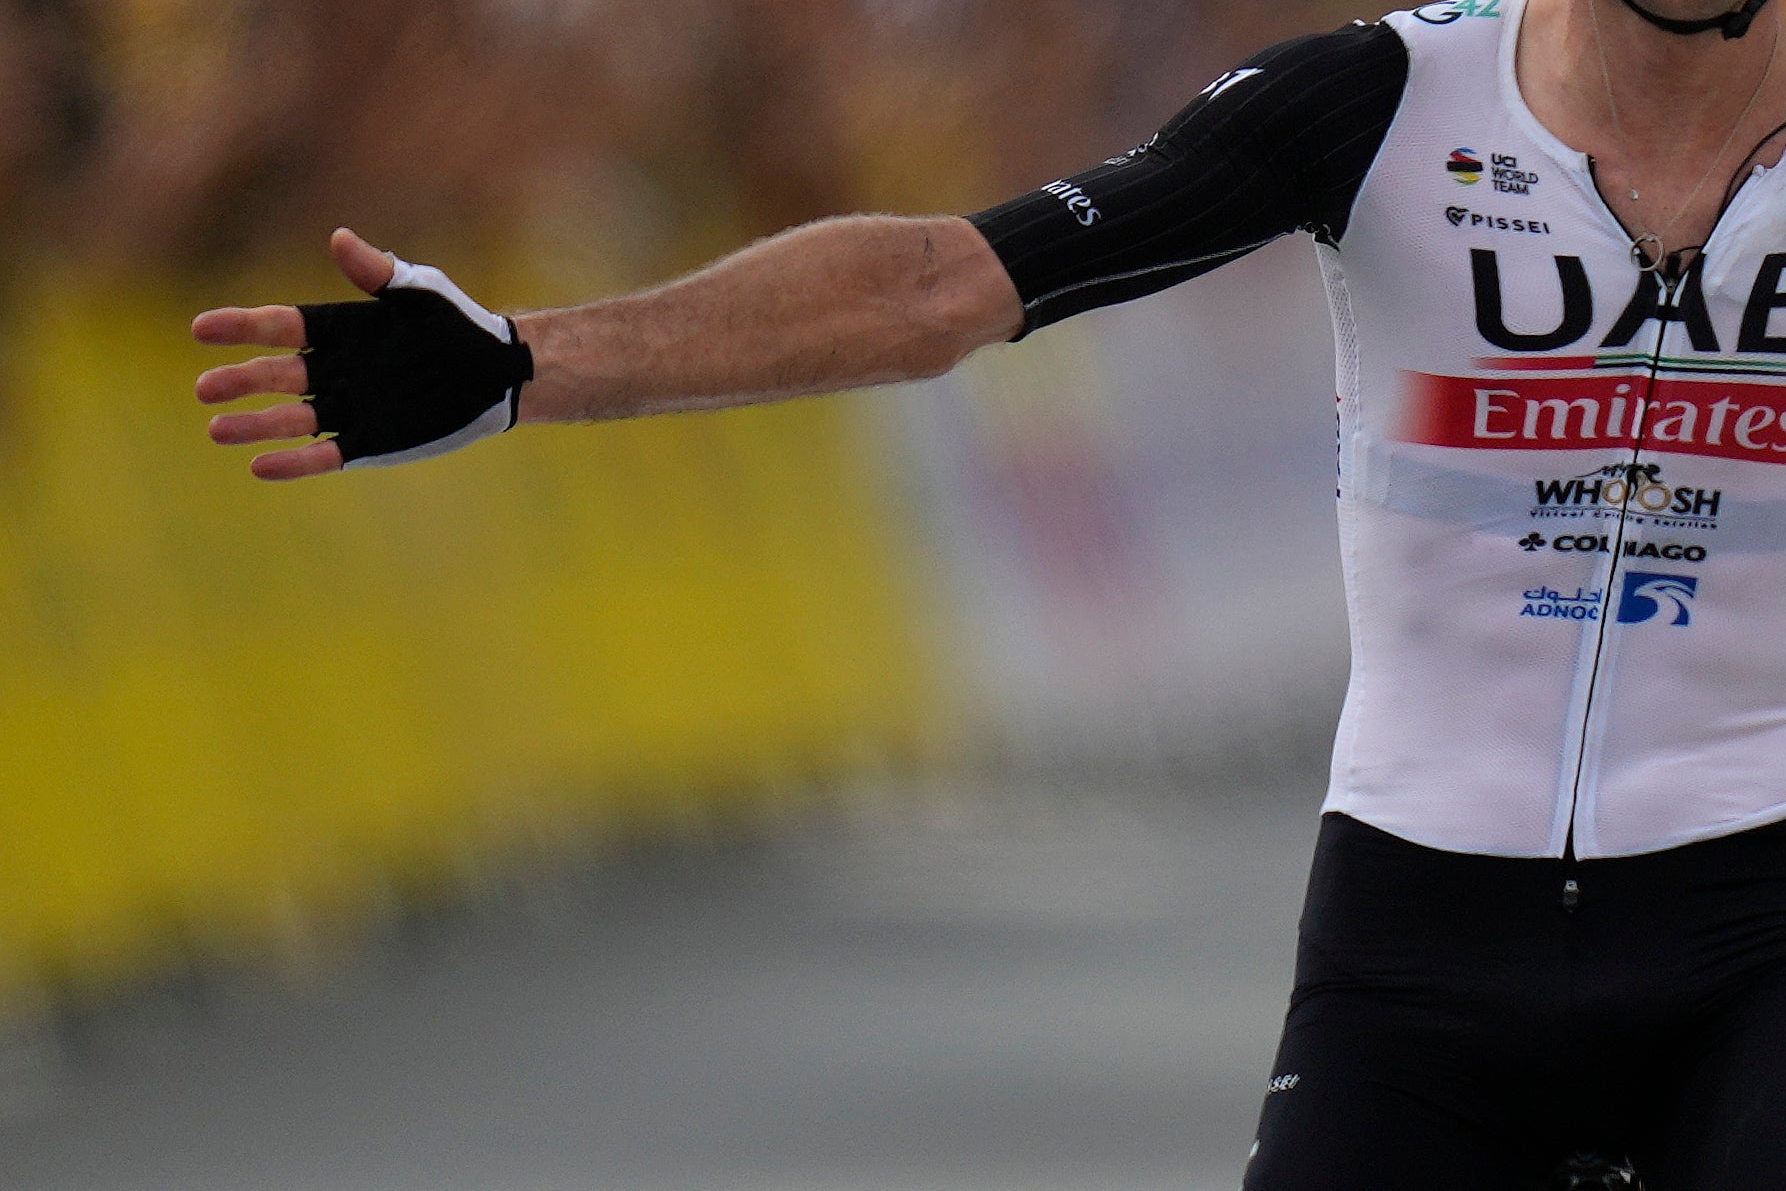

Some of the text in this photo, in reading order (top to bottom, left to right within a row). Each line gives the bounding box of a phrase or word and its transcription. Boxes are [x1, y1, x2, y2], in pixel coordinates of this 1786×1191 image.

[1491, 153, 1517, 168] UCI
[1491, 167, 1539, 184] WORLD
[1491, 179, 1530, 195] TEAM
[1471, 214, 1550, 234] PISSEI
[1536, 478, 1721, 517] WHOOSH
